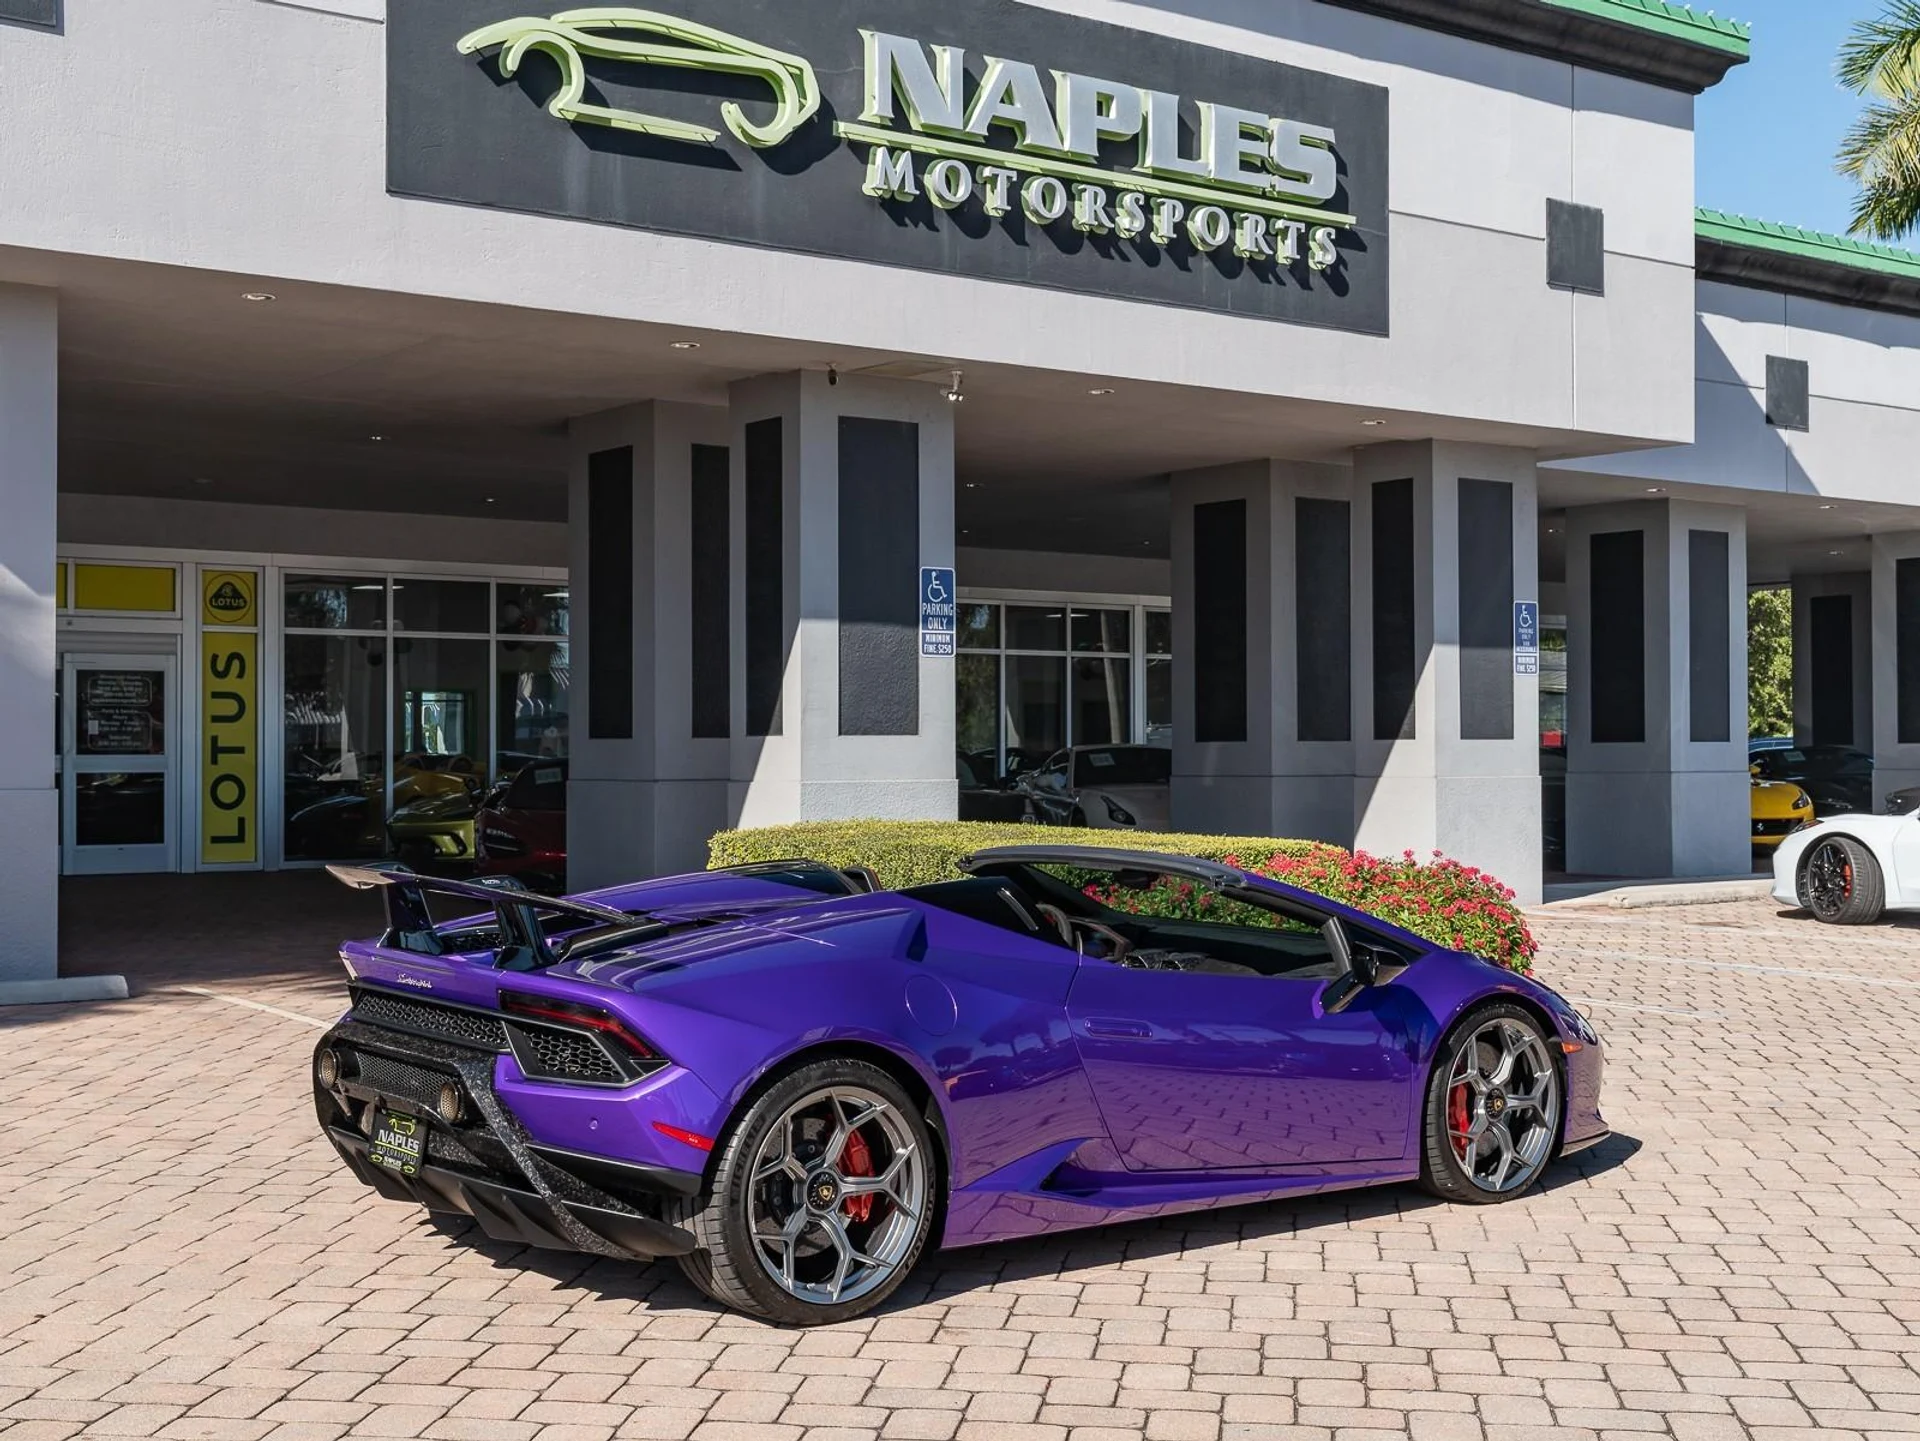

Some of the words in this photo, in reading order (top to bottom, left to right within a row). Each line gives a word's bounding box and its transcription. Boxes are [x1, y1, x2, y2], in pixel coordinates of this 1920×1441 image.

[857, 28, 1338, 206] NAPLES
[863, 145, 1337, 270] MOTORSPORTS
[212, 597, 245, 607] LOTUS
[922, 602, 953, 616] PARKING
[927, 617, 947, 630] ONLY
[210, 651, 246, 844] LOTUS
[378, 1129, 420, 1153] NAPLES
